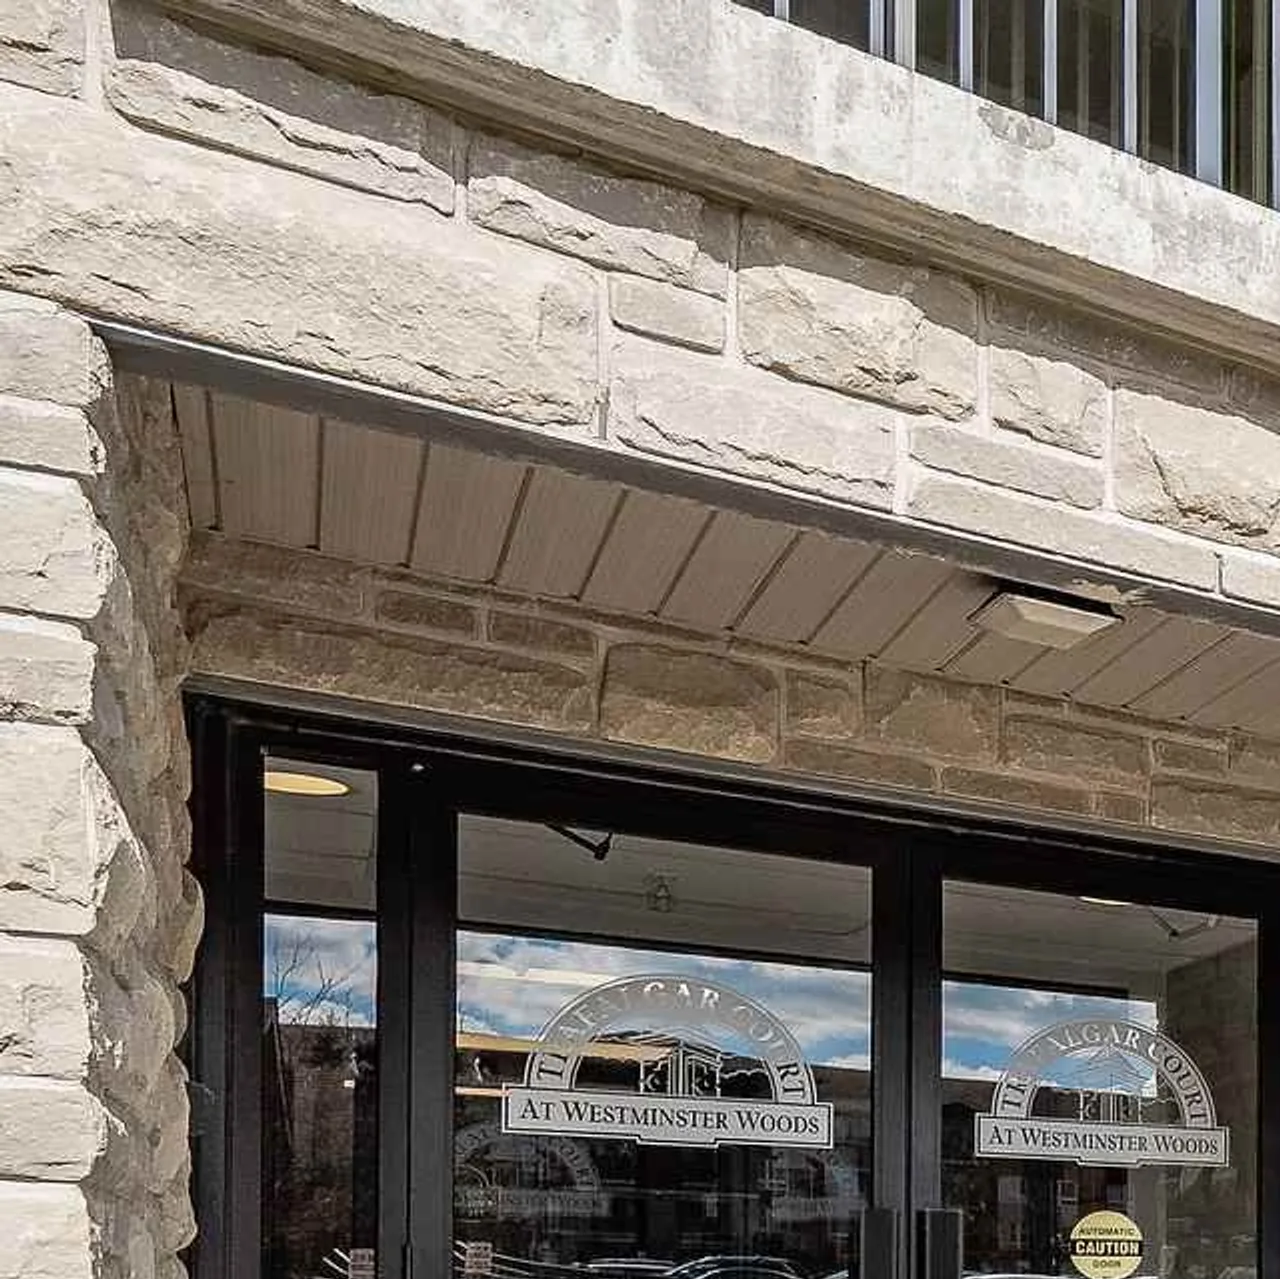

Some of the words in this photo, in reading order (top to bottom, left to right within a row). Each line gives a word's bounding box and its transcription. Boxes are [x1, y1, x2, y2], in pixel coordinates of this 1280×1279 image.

[1148, 1040, 1208, 1121] COURT
[563, 1102, 729, 1129] WESTMINSTER
[734, 1112, 820, 1135] WOODS
[1079, 1228, 1135, 1236] AUTOMATIC
[1075, 1241, 1139, 1255] CAUTION
